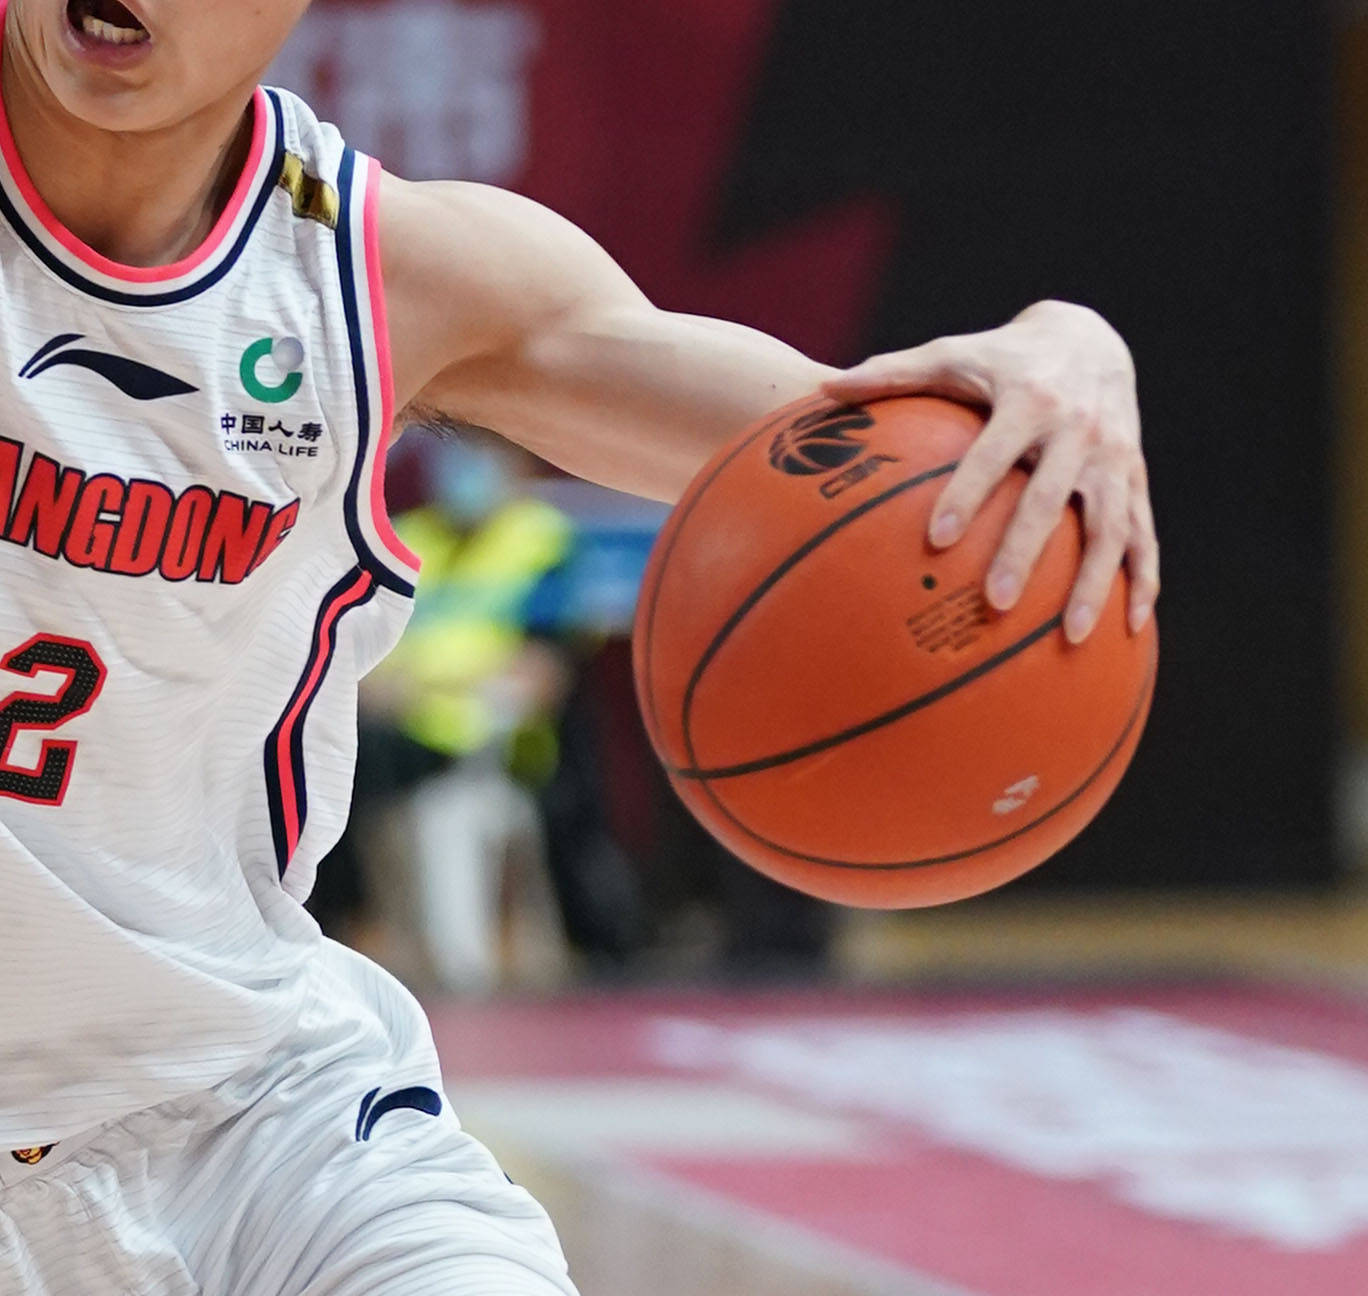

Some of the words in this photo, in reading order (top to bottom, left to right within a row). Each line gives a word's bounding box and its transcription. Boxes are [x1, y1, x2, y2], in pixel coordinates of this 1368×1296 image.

[220, 413, 323, 442] 中国人寿
[224, 439, 273, 452] CHINA
[278, 443, 319, 457] LIFE
